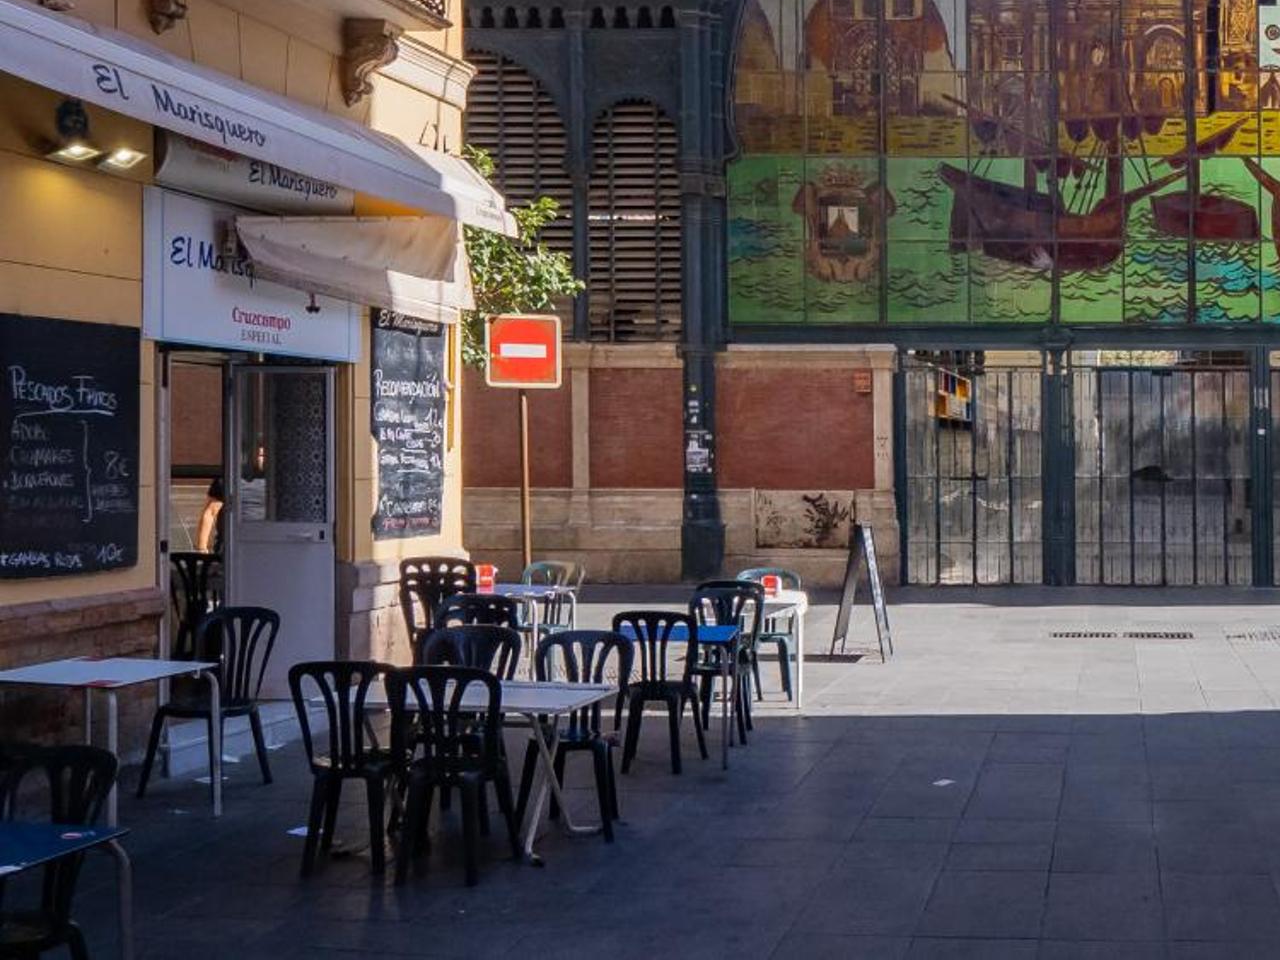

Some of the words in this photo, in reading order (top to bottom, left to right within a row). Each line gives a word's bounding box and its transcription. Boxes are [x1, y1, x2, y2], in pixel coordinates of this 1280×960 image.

[92, 64, 129, 100] El
[151, 84, 266, 147] Marisquero
[249, 161, 266, 185] El
[269, 166, 339, 201] Marisquero
[170, 237, 193, 268] El
[231, 306, 291, 332] Cruzcampo
